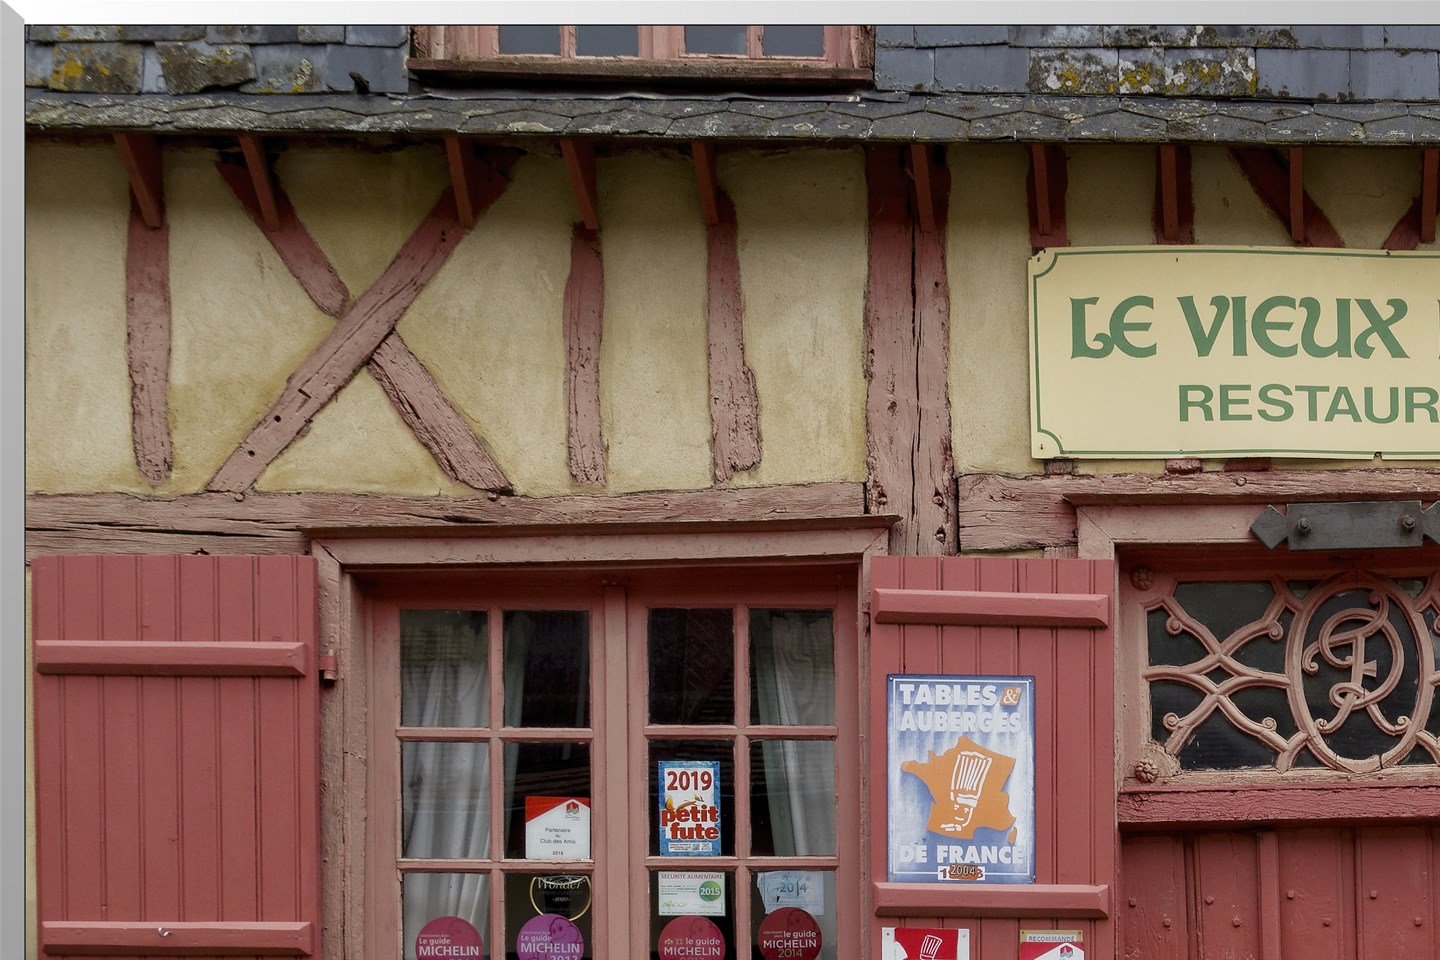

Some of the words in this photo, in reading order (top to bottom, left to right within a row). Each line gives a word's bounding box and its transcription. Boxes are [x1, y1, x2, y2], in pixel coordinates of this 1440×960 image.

[1069, 294, 1157, 360] LE
[1177, 294, 1410, 360] VIEUX
[899, 684, 998, 706] TABLES
[899, 711, 1023, 733] AUBERGES
[667, 770, 712, 791] 2019
[661, 804, 719, 827] petit
[899, 845, 928, 863] DE
[937, 845, 1024, 864] FRANCE
[950, 864, 977, 876] 2004
[700, 887, 720, 896] 2015
[531, 934, 552, 942] guide
[784, 930, 791, 938] le
[793, 930, 816, 939] guide
[429, 937, 451, 945] guide
[696, 937, 720, 946] guide
[763, 939, 817, 949] MICHELIN
[418, 945, 479, 956] MICHELIN
[521, 942, 580, 954] MICHELIN
[664, 946, 720, 956] MICHELIN
[778, 948, 802, 958] 2014
